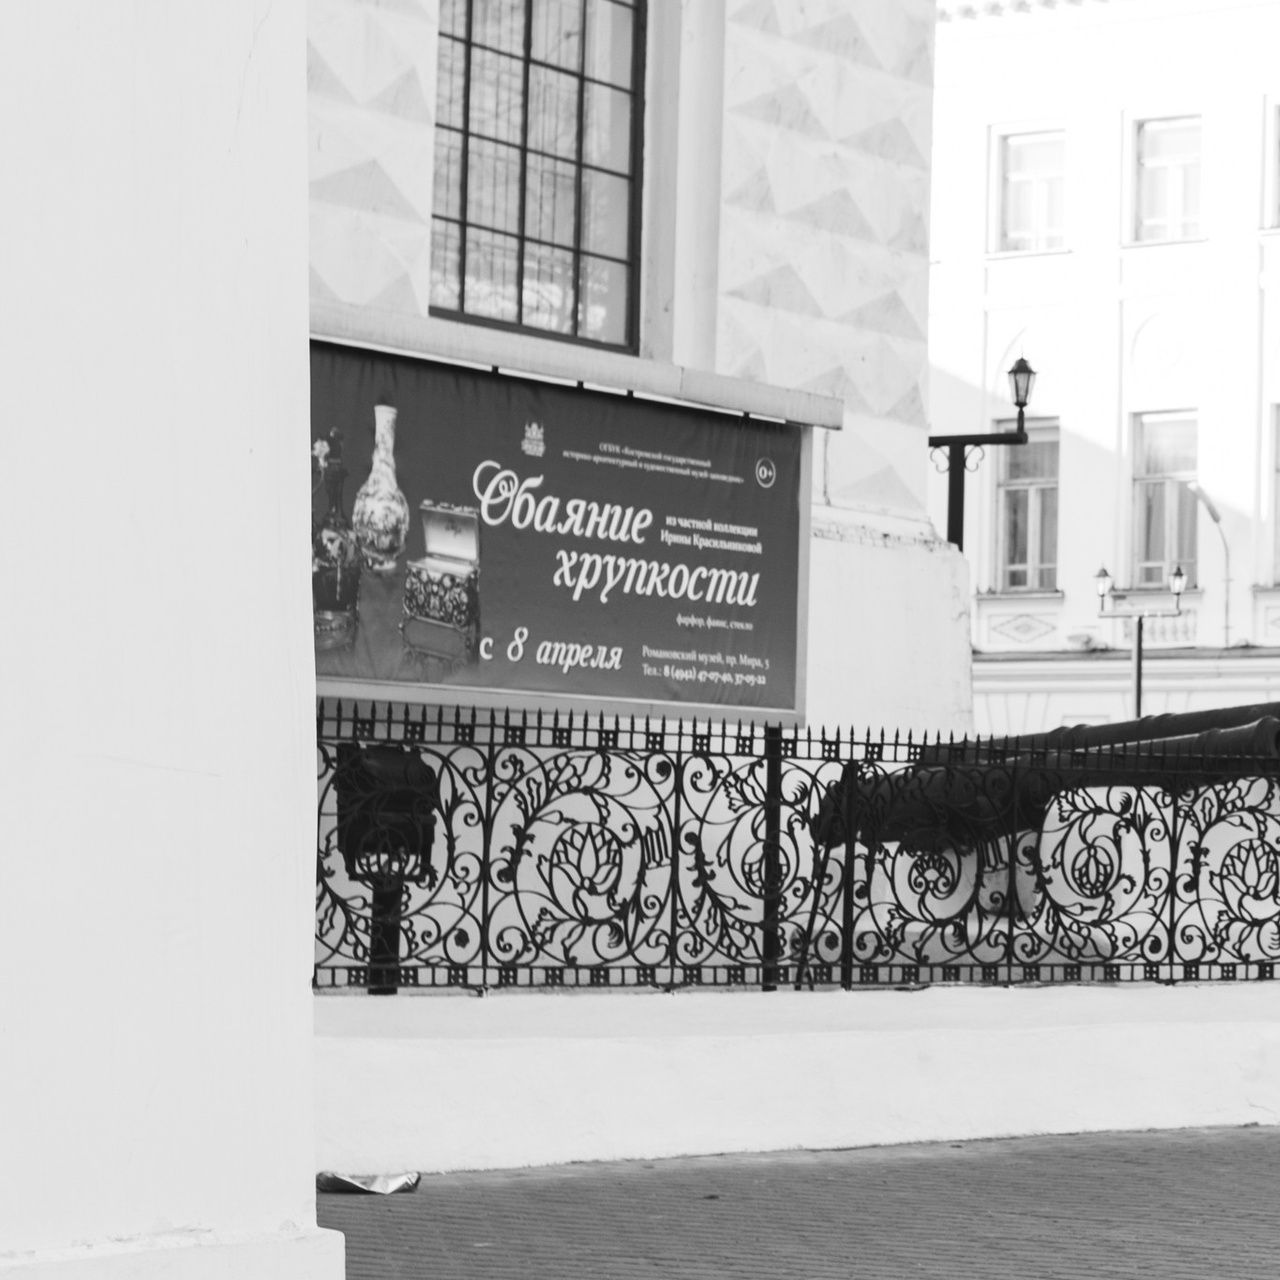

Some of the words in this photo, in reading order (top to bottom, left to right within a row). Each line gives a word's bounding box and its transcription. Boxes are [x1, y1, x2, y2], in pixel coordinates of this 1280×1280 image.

[759, 466, 773, 479] 0+
[473, 460, 653, 544] Обаяние
[666, 516, 676, 527] из
[677, 518, 712, 531] частной
[713, 522, 758, 537] коллекции
[661, 529, 691, 546] Ирины
[693, 533, 762, 554] Красильниковой
[553, 550, 760, 607] хрупкости
[480, 636, 493, 660] с
[507, 626, 529, 662] 8
[536, 639, 623, 674] апреля
[642, 644, 697, 661] Романовский
[698, 651, 724, 665] музей,
[739, 654, 763, 669] Мира,
[765, 658, 770, 670] 5
[663, 665, 670, 677] 8
